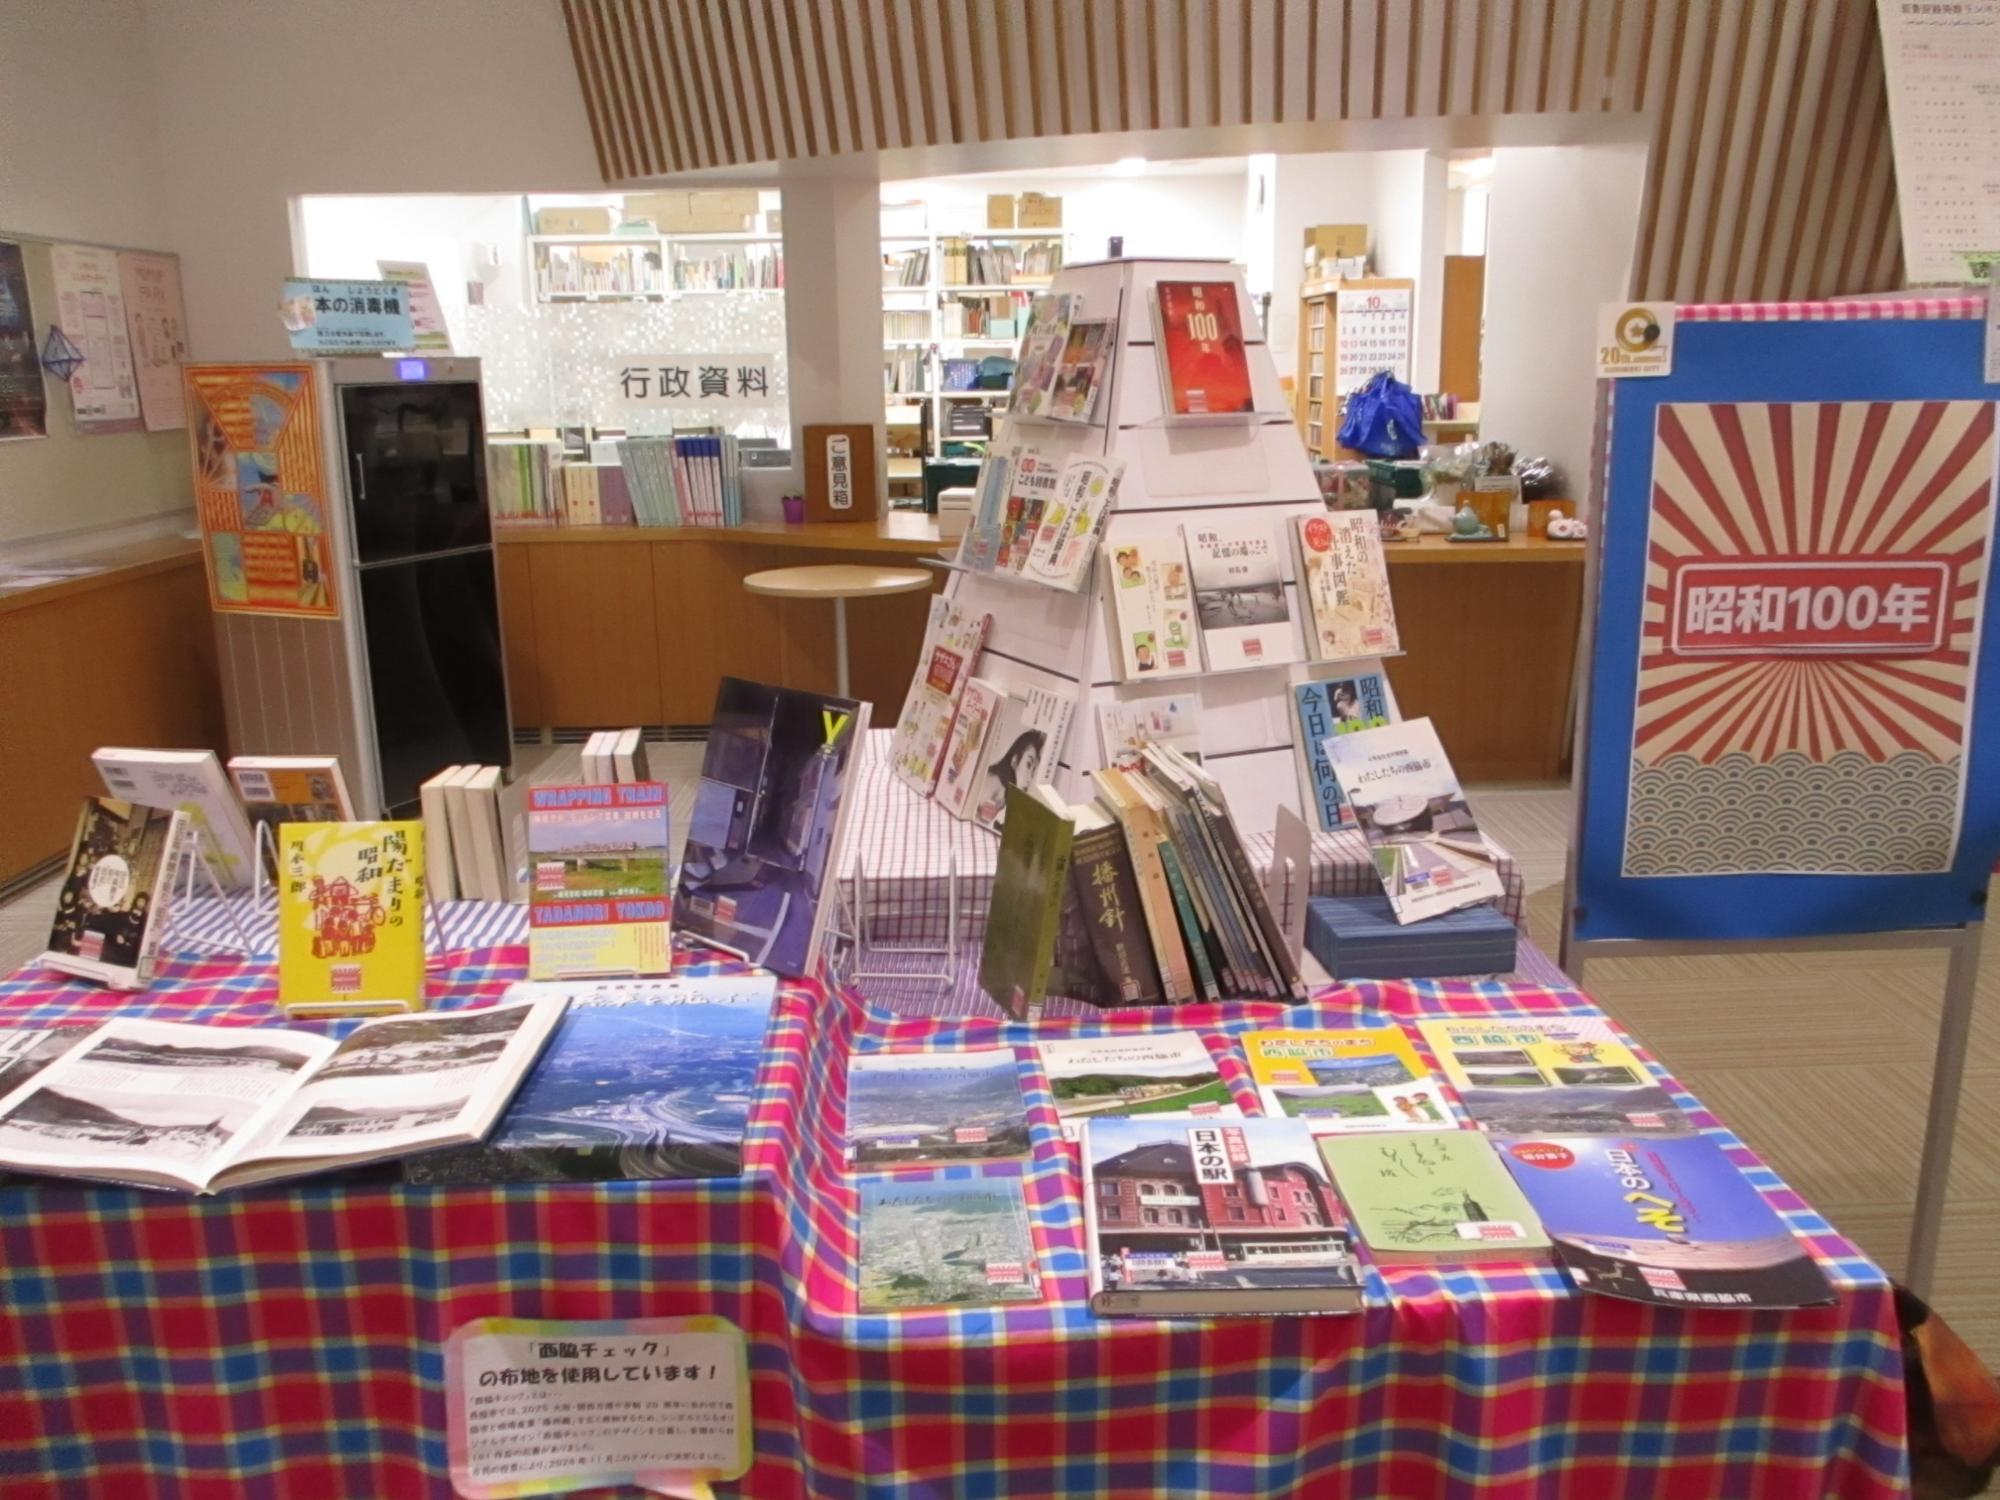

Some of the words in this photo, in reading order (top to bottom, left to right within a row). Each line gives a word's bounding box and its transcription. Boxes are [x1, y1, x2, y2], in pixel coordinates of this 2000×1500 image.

[315, 297, 400, 315] 本の消毒機
[1367, 297, 1381, 309] 10
[620, 366, 769, 398] 行政資料
[830, 437, 850, 506] ご意見箱
[1339, 527, 1359, 575] 消えた
[1349, 517, 1369, 563] 昭和の
[1685, 582, 1931, 635] 昭和100年
[1359, 676, 1384, 719] 昭和
[822, 710, 849, 745] Y
[1302, 686, 1343, 827] 今日は何の日
[534, 787, 612, 807] WRAPPING
[617, 784, 662, 803] TRAIN
[290, 840, 306, 894] 川本三郎
[354, 846, 383, 883] 昭和
[383, 830, 412, 927] 陽だまりの
[535, 903, 609, 924] TADANORI
[1194, 1130, 1229, 1181] 日本の駅
[527, 1341, 671, 1360] 「西脇チェック」
[479, 1364, 718, 1387] の布地を使用しています！
